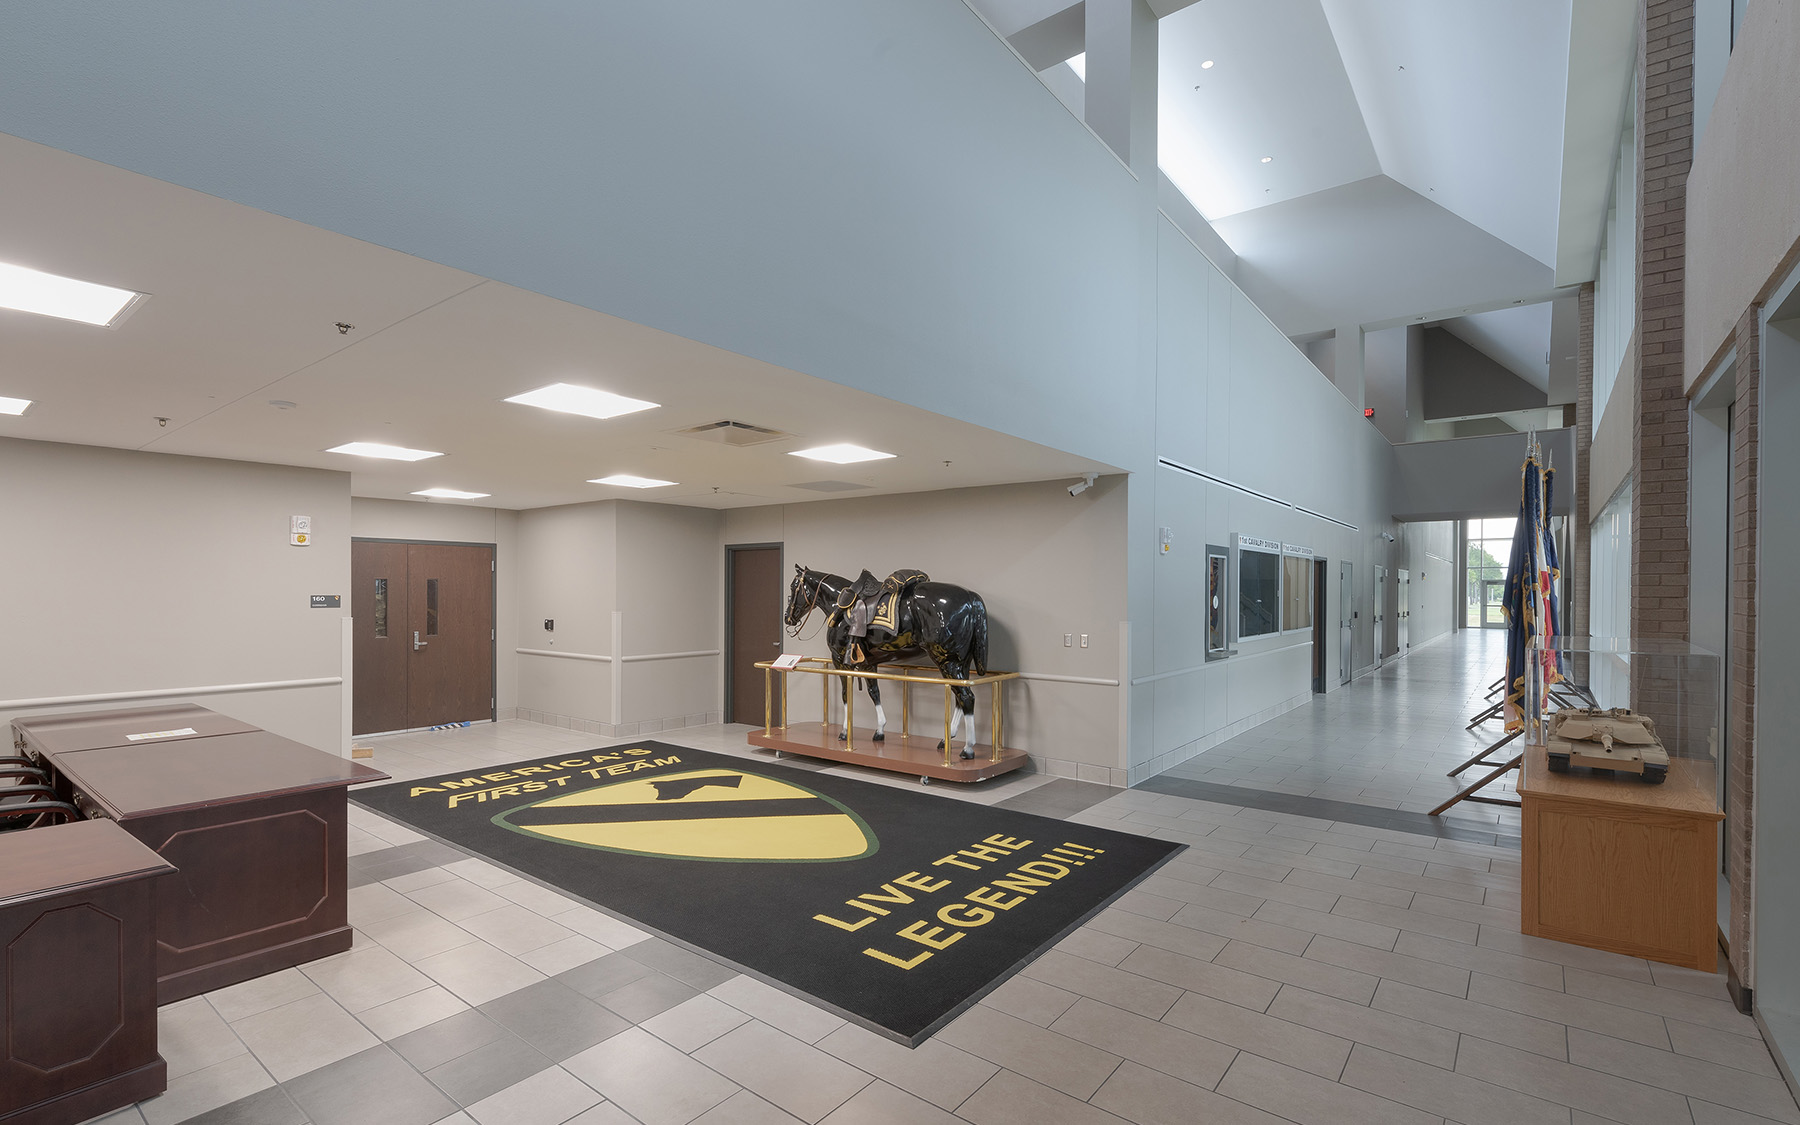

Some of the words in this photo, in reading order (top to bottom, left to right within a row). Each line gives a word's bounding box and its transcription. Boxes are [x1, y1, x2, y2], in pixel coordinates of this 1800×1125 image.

[1265, 541, 1279, 549] DIVISION
[410, 748, 652, 797] AMERICA'S
[448, 776, 572, 808] FIRST
[581, 755, 682, 779] TEAM
[812, 871, 952, 932] LIVE
[931, 833, 1033, 871] THE
[862, 842, 1105, 970] LEGEND!!!
